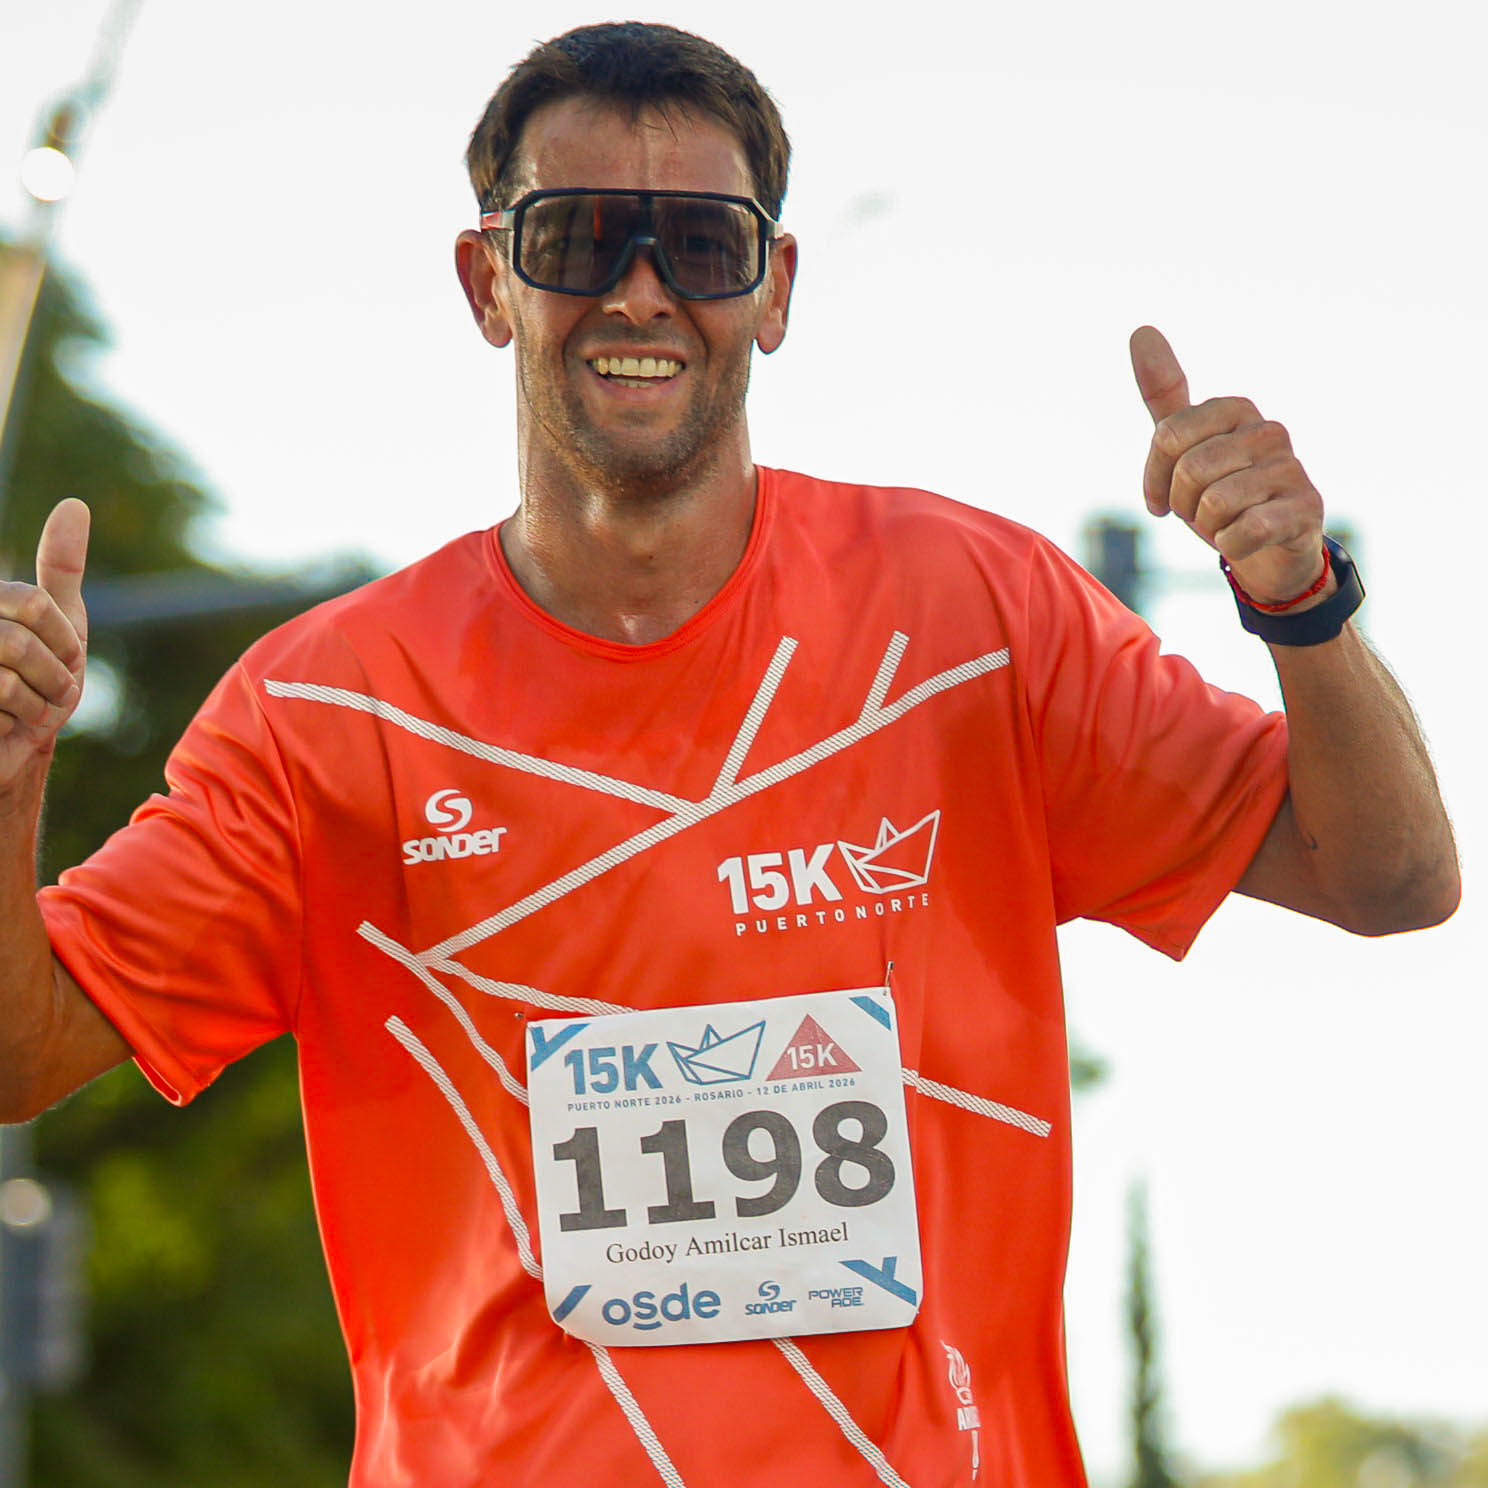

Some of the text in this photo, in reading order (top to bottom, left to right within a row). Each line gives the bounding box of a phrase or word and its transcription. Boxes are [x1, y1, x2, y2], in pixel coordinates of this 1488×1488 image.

[716, 843, 844, 915] 15K
[564, 1043, 664, 1095] 15K
[786, 1043, 838, 1070] 15K
[567, 1101, 610, 1112] PUERTO
[614, 1097, 651, 1109] NORTE
[694, 1089, 744, 1101] ROSARIO
[756, 1086, 769, 1096] 12
[773, 1084, 788, 1094] DE
[792, 1080, 825, 1092] ABRIL
[828, 1078, 856, 1089] 2026
[552, 1100, 896, 1232] 1198
[606, 1222, 849, 1264] Godoy Amilcar Ismael
[602, 1281, 721, 1329] osde
[808, 1286, 864, 1301] POWER
